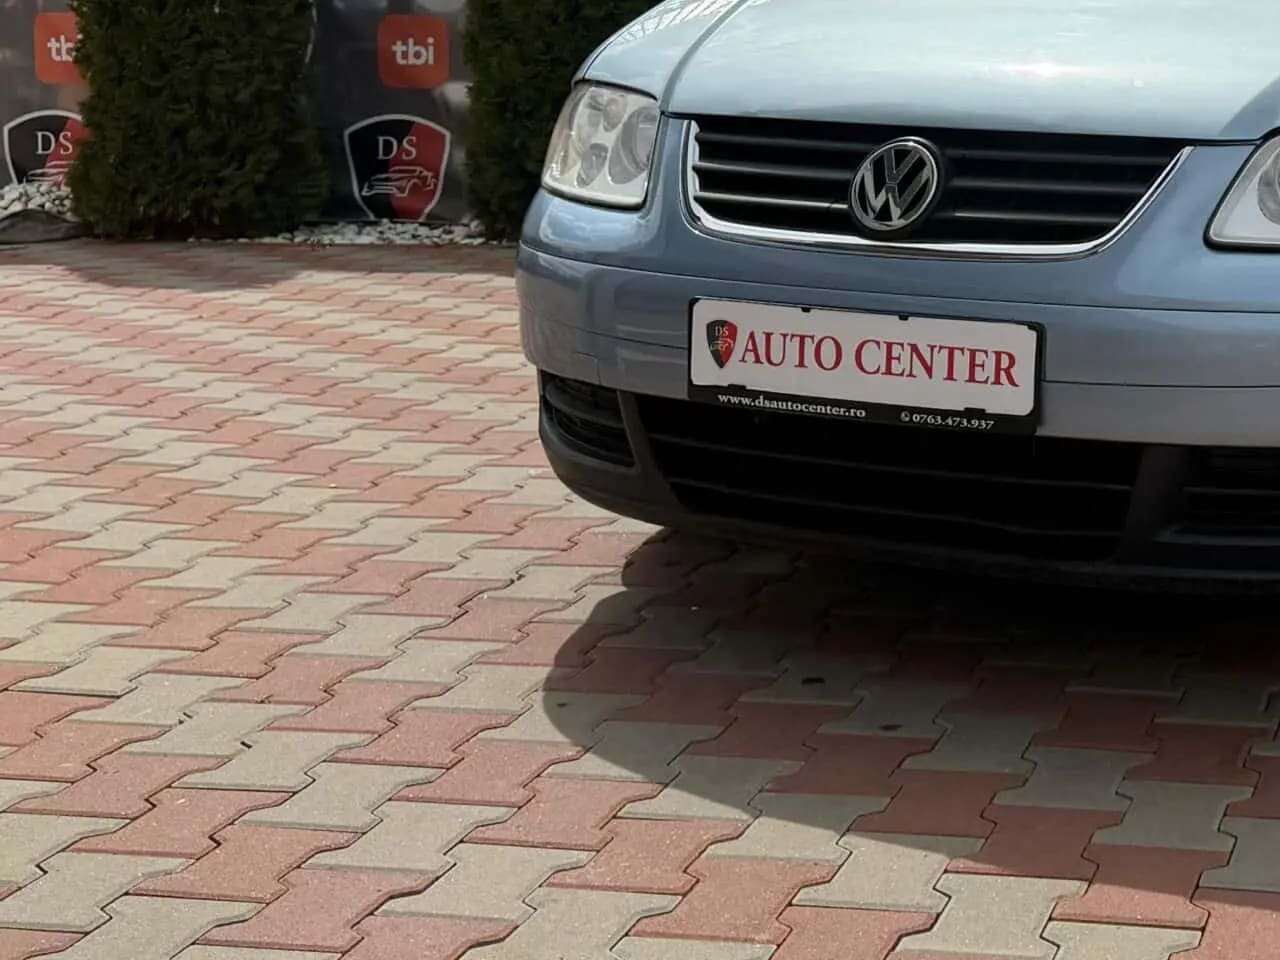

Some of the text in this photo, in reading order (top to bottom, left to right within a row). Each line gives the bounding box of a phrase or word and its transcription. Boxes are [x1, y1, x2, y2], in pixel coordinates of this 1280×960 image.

[48, 35, 83, 61] tb
[392, 37, 435, 65] tbi
[36, 132, 73, 153] DS
[377, 137, 416, 160] DS
[738, 330, 1021, 388] AUTO CENTER
[717, 393, 866, 418] www.dsautocenter.ro
[912, 413, 995, 430] 0763.473.937
